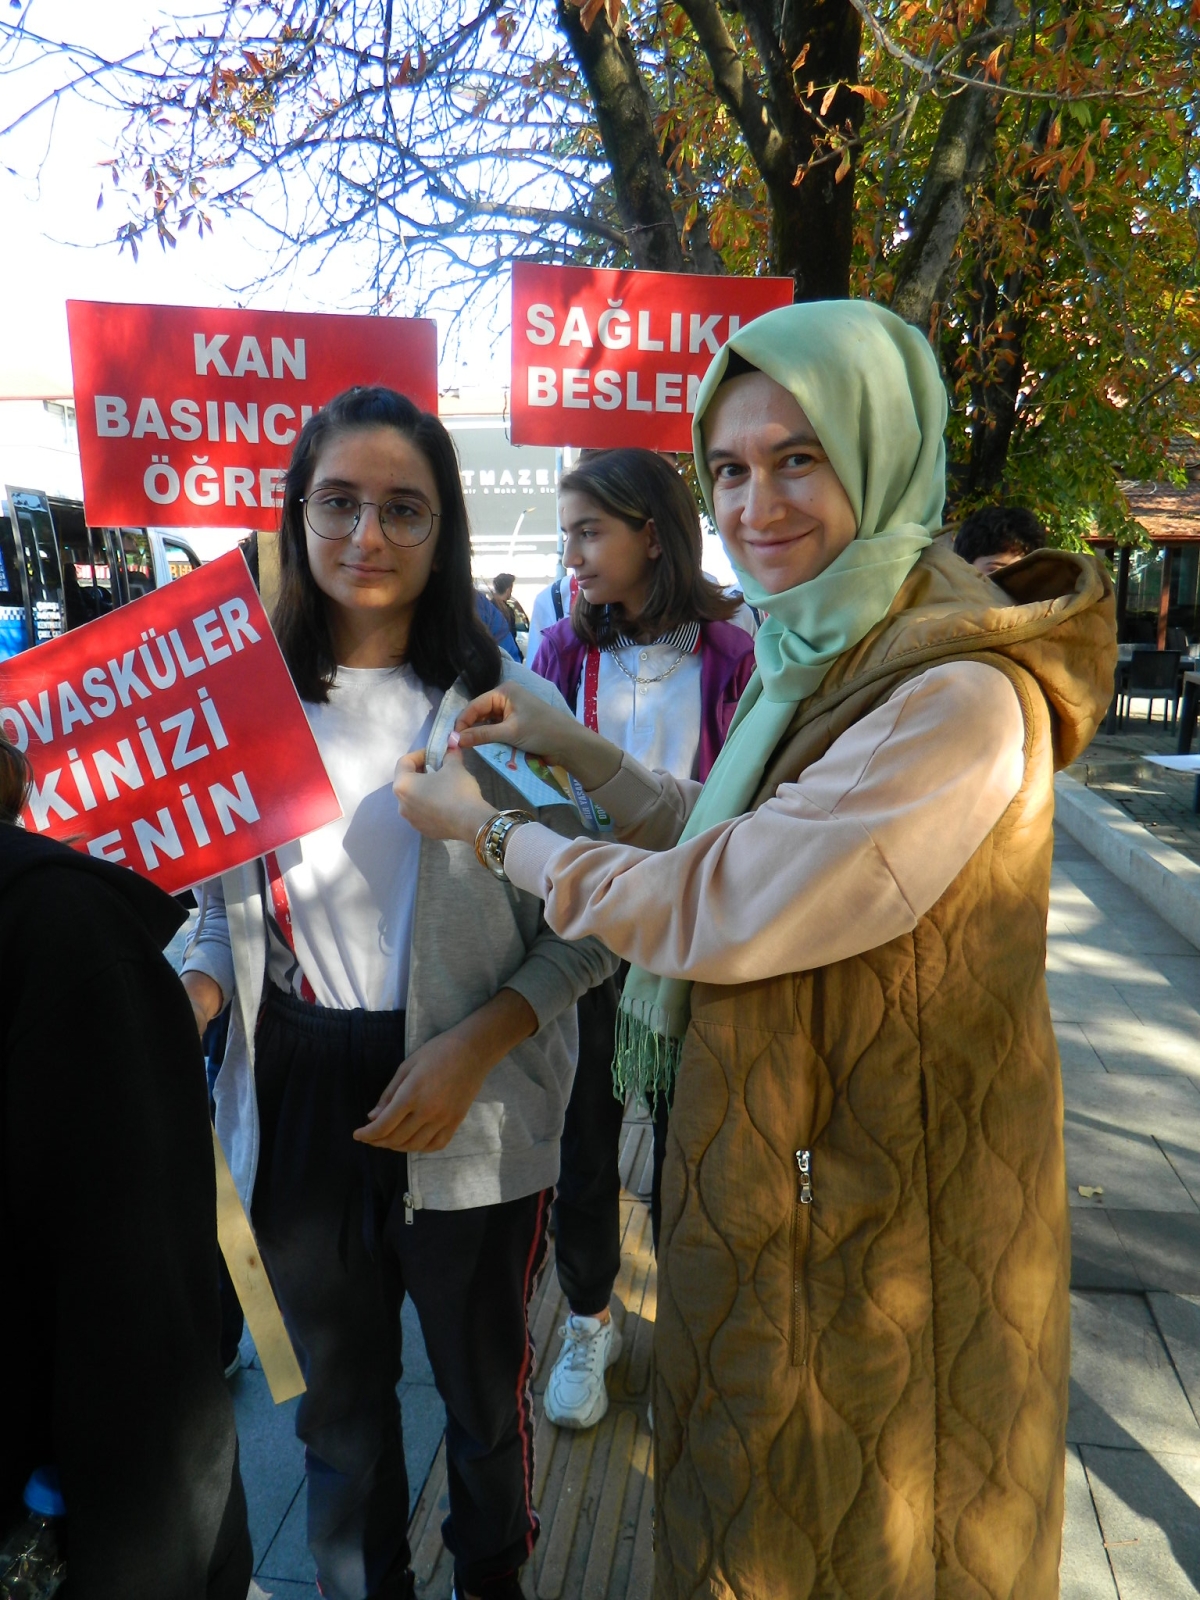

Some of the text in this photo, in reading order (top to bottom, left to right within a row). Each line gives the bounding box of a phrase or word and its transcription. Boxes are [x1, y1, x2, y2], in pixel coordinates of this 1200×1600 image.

[193, 333, 306, 380] KAN
[94, 395, 323, 446] BASINC
[143, 455, 288, 508] ÖĞRE
[16, 687, 229, 832] KİNİZİ
